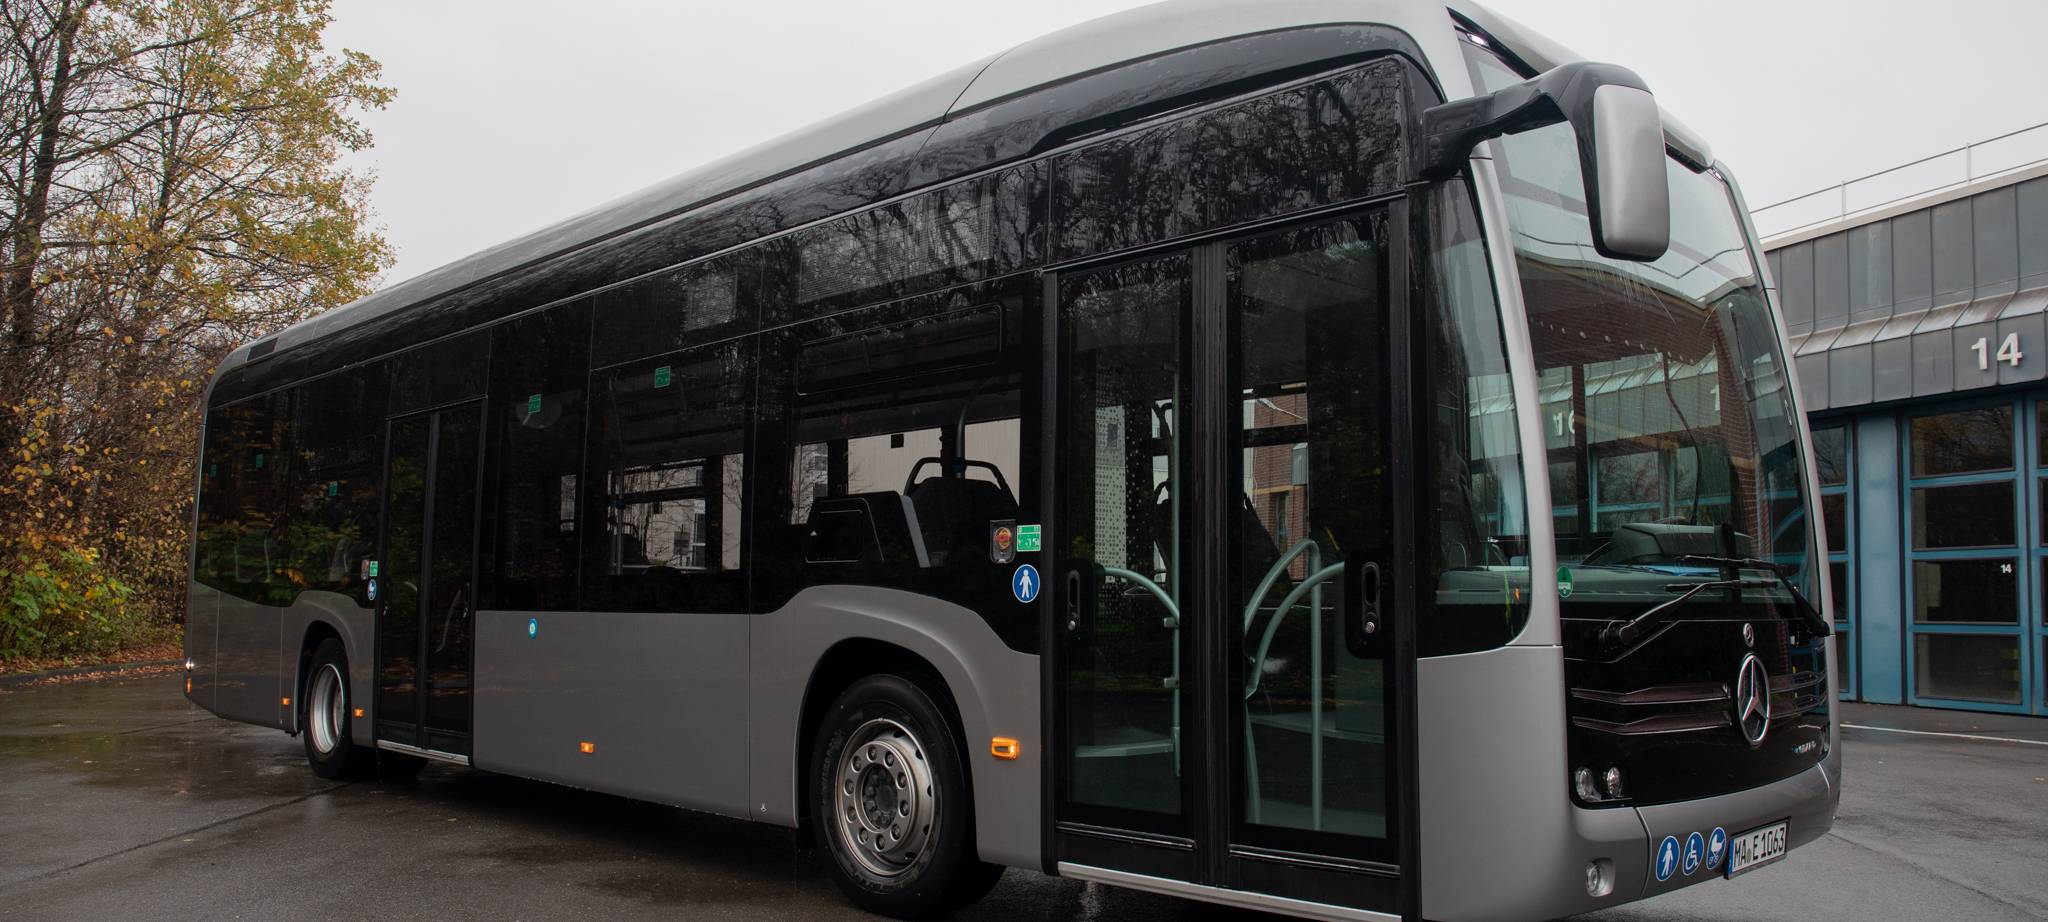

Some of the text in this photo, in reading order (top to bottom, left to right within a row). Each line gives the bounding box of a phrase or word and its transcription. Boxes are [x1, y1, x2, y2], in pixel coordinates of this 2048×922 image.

[1971, 332, 2023, 370] 14
[2000, 563, 2012, 574] 14
[1733, 838, 1746, 867] MA
[1761, 827, 1785, 858] 1063
